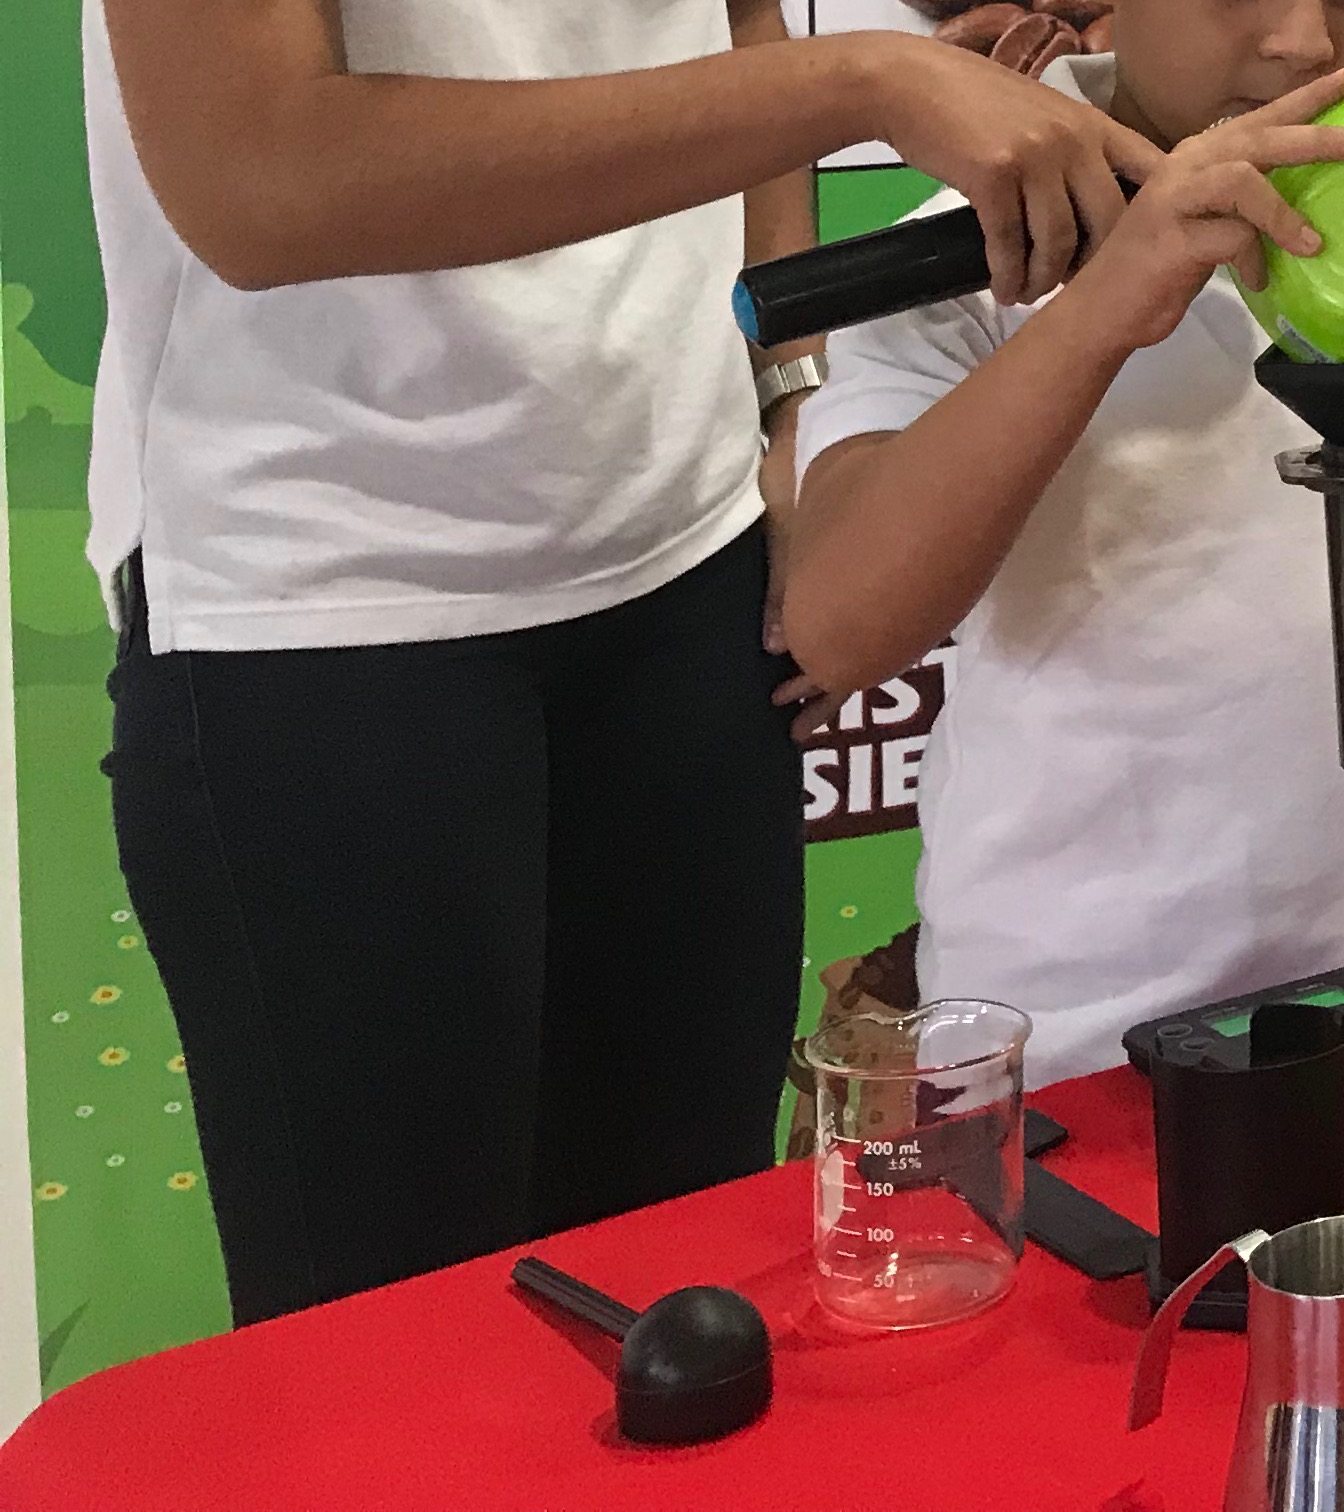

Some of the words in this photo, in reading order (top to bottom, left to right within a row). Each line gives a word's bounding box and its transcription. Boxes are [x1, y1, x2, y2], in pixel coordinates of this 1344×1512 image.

[802, 734, 933, 821] SIE
[863, 1141, 893, 1155] 200
[899, 1140, 921, 1153] mL
[866, 1181, 893, 1196] 150
[866, 1227, 893, 1242] 100
[873, 1274, 894, 1287] 50
